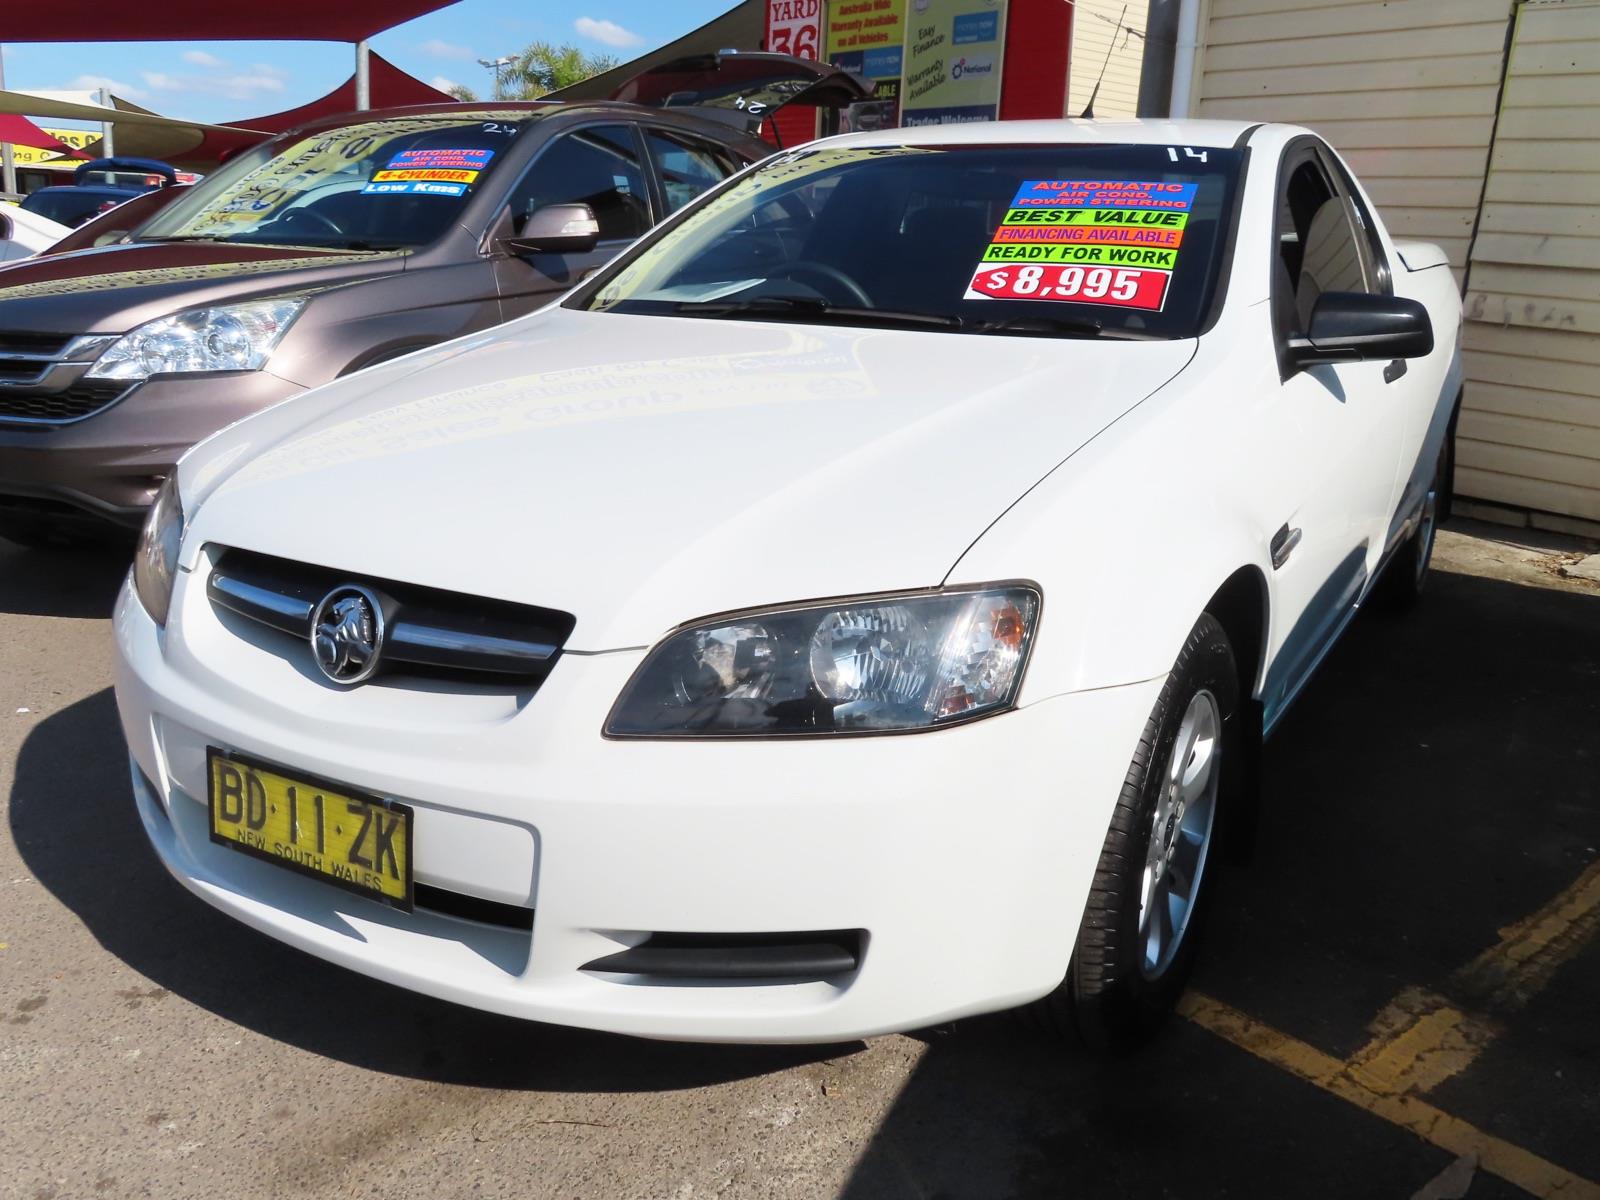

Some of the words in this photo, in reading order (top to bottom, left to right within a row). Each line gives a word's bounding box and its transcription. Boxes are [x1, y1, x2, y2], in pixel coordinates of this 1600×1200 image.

[772, 0, 818, 21] YARD
[918, 25, 936, 40] Easy
[913, 34, 945, 58] Finance
[907, 59, 944, 86] Warranty
[910, 74, 946, 102] Available
[1167, 147, 1208, 162] 14
[379, 170, 470, 181] 4-CYLINDER
[365, 184, 409, 193] Low
[412, 183, 462, 194] Kms
[1033, 181, 1184, 193] AUTOMATIC
[1058, 191, 1090, 199] AIR
[1017, 198, 1084, 206] POWER
[1089, 199, 1187, 208] STEERING
[1006, 210, 1083, 223] BEST
[1093, 211, 1185, 226] VALUE
[999, 228, 1085, 240] FINANCING
[1086, 229, 1176, 244] AVAILABLE
[988, 246, 1056, 259] READY
[1061, 247, 1104, 260] FOR
[1108, 249, 1172, 265] WORK
[237, 828, 266, 850] NEW
[274, 842, 323, 871] SOUTH
[331, 862, 382, 891] WALES
